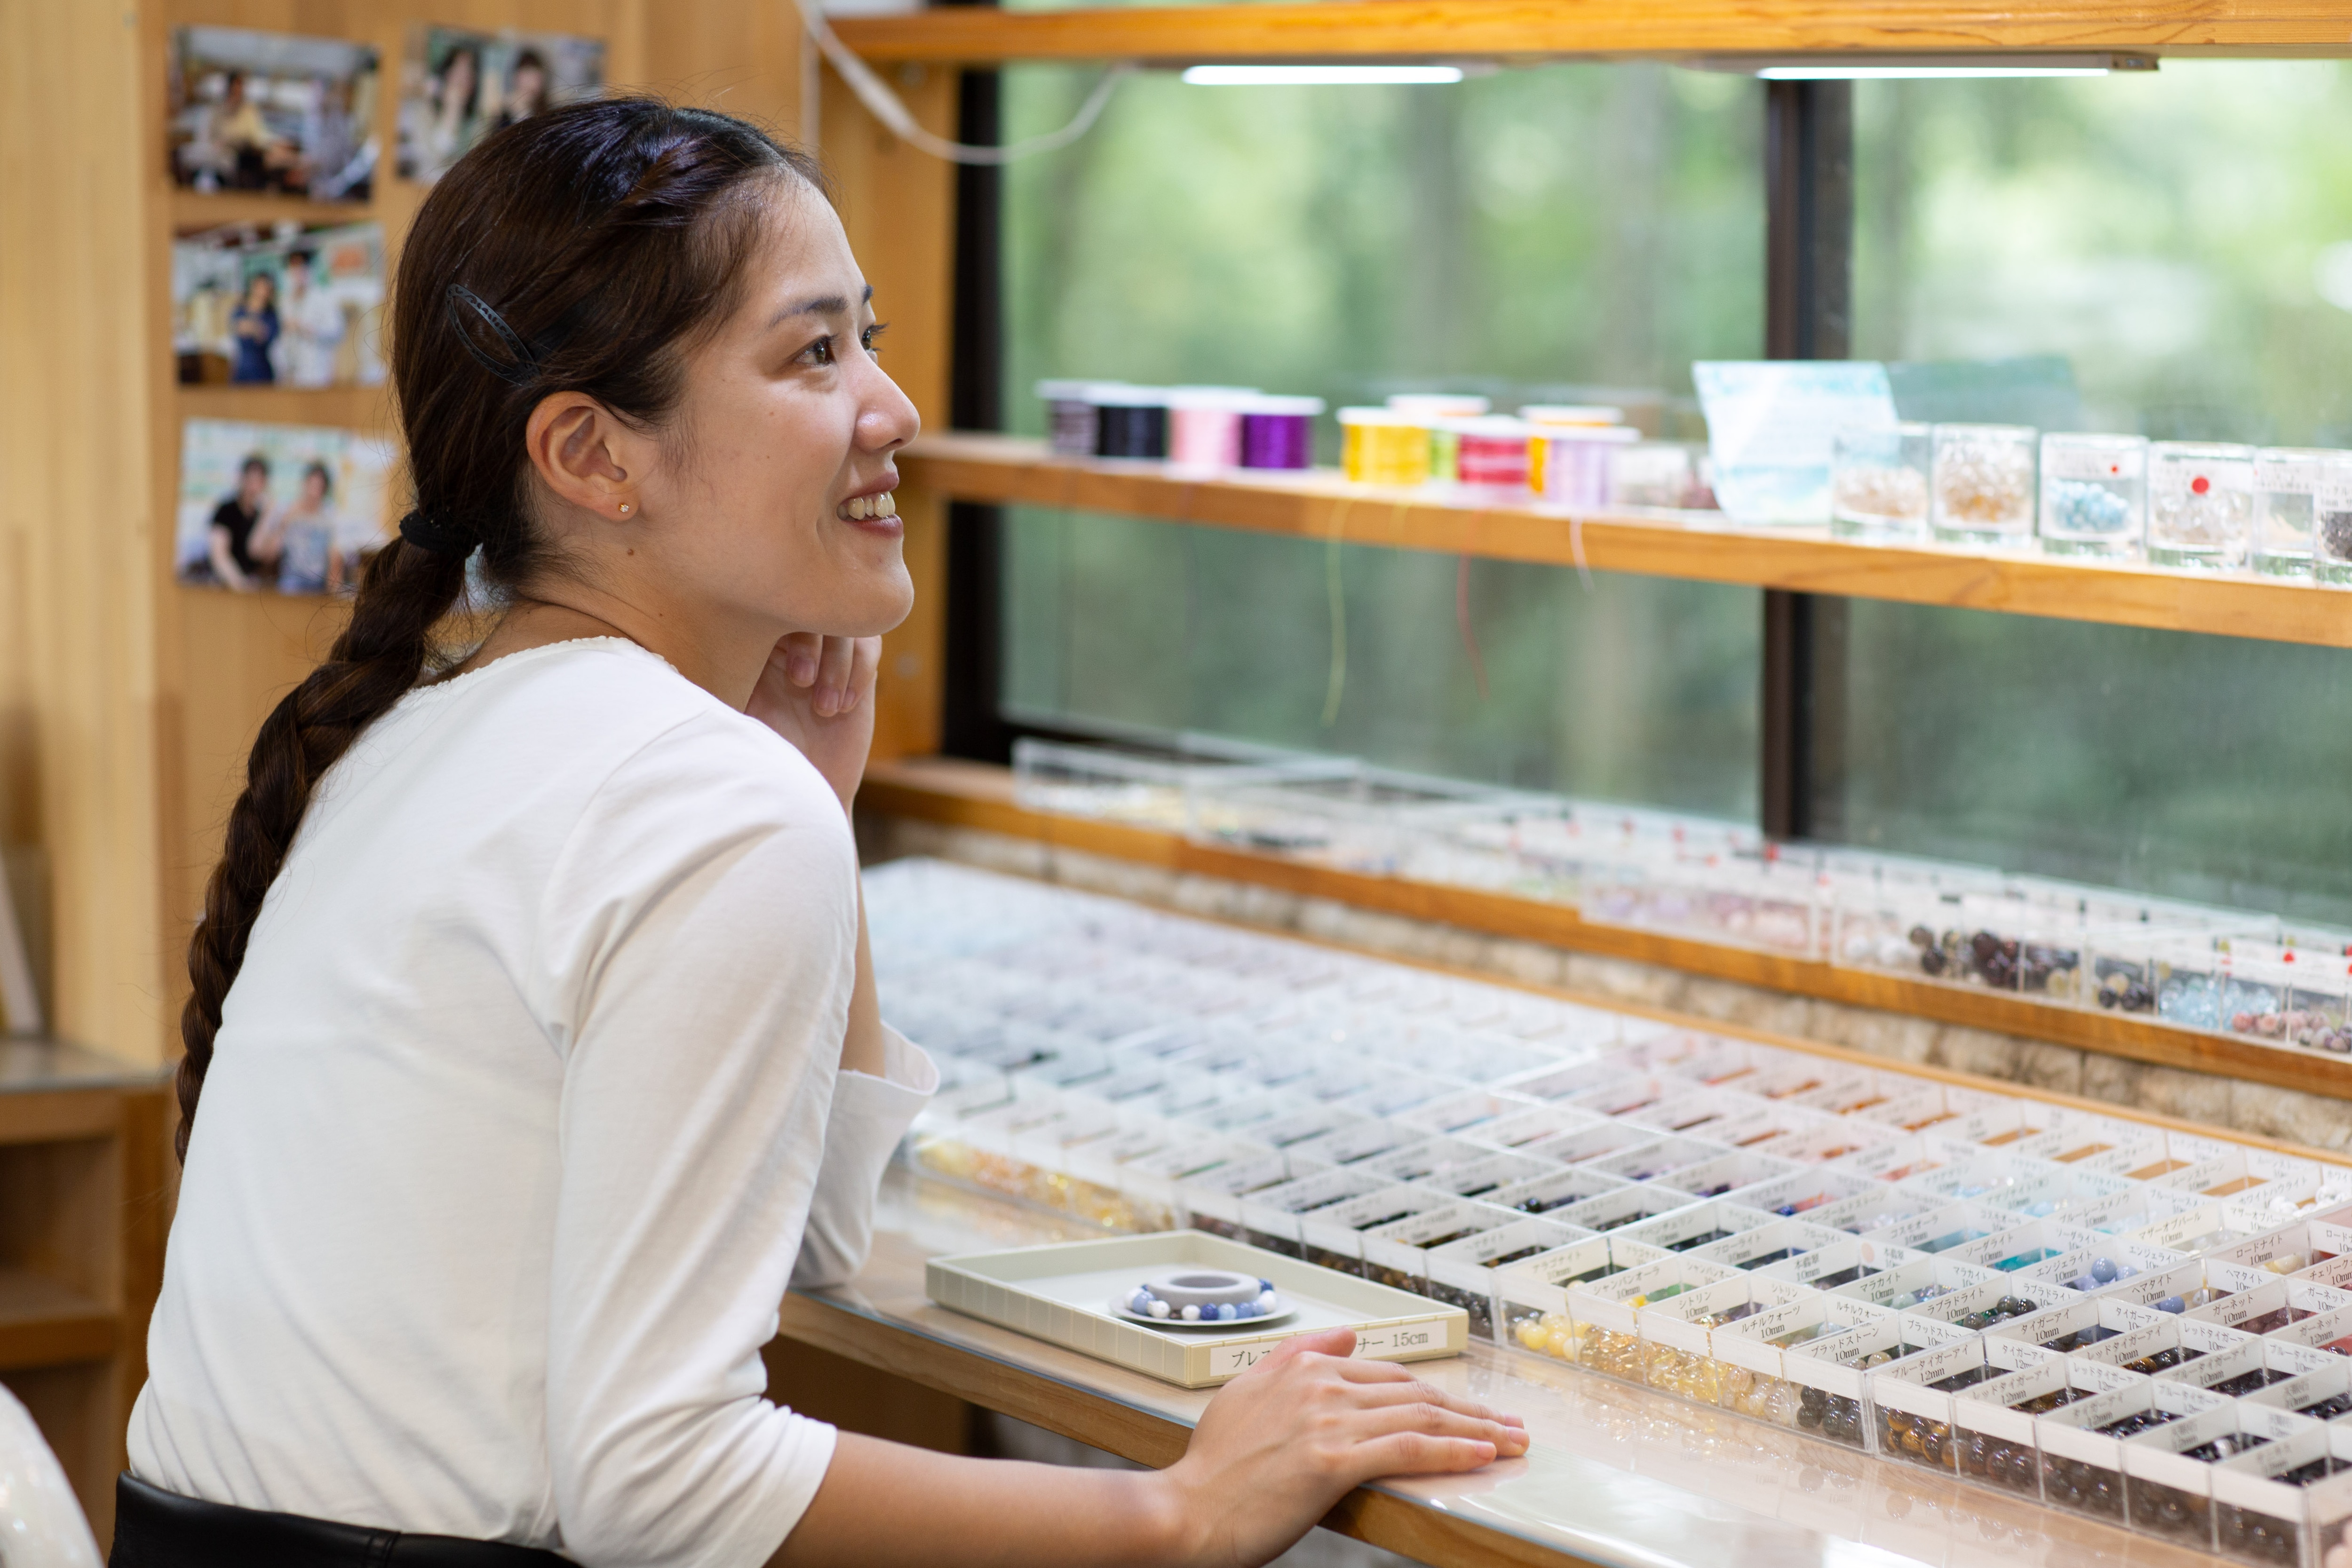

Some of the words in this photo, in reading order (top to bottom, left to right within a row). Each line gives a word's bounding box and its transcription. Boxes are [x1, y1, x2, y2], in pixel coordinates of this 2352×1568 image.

[1891, 1214, 1939, 1239] コスモオーラ
[2085, 1214, 2107, 1228] 10mm
[2138, 1212, 2201, 1240] マザーオブパール
[1905, 1231, 1928, 1246] 10mm
[1965, 1234, 2013, 1257] ソーダライト
[2161, 1230, 2183, 1245] 10mm
[2237, 1234, 2282, 1258] ロードナイト
[1980, 1250, 2003, 1264] 10mm
[2036, 1250, 2092, 1277] エンジェライト
[2250, 1251, 2273, 1266] 10mm
[1796, 1267, 1820, 1281] 10mm
[2055, 1268, 2078, 1283] 10mm
[2226, 1269, 2263, 1284] ヘマタイト
[2310, 1259, 2352, 1281] チェリーク
[1594, 1266, 1660, 1295] シャンパンオーラ
[1859, 1272, 1901, 1292] マラカイト
[2132, 1274, 2172, 1294] ヘマタイト
[1617, 1285, 1641, 1299] 10mm
[1772, 1282, 1797, 1297] シトリン
[1871, 1288, 1894, 1302] 10mm
[2142, 1289, 2165, 1304] 10mm
[2307, 1286, 2346, 1304] ガーネット
[1679, 1291, 1712, 1310] シトリン
[1927, 1288, 1984, 1315] ラブラドライト
[2213, 1294, 2253, 1316] ガーネット
[1685, 1305, 1709, 1319] 10mm
[1741, 1305, 1800, 1334] ルチルクォーツ
[1946, 1305, 1970, 1321] 10mm
[2225, 1309, 2247, 1324] 10mm
[1908, 1320, 1961, 1339] ブラッドストー
[2021, 1309, 2070, 1335] タイガーアイ
[2299, 1313, 2340, 1338] ガーネット
[1392, 1331, 1429, 1347] 15cm
[1761, 1323, 1785, 1339] 10mm
[2035, 1326, 2059, 1341] 10mm
[2184, 1322, 2245, 1343] レッドタイガー
[2310, 1330, 2334, 1345] 12mm
[1811, 1327, 1879, 1358] ブラッドストーン
[2087, 1326, 2161, 1360] レッドタイガーアイ
[1835, 1346, 1860, 1362] 10mm
[2002, 1344, 2045, 1362] タイガーアイ
[2115, 1349, 2138, 1364] 10mm
[1891, 1344, 1968, 1379] ブルータイガーアイ
[1920, 1368, 1945, 1382] 12mm
[2200, 1369, 2225, 1385] 10mm
[1972, 1367, 2050, 1400] レッドタイガーアイ
[2002, 1390, 2027, 1405] 12mm
